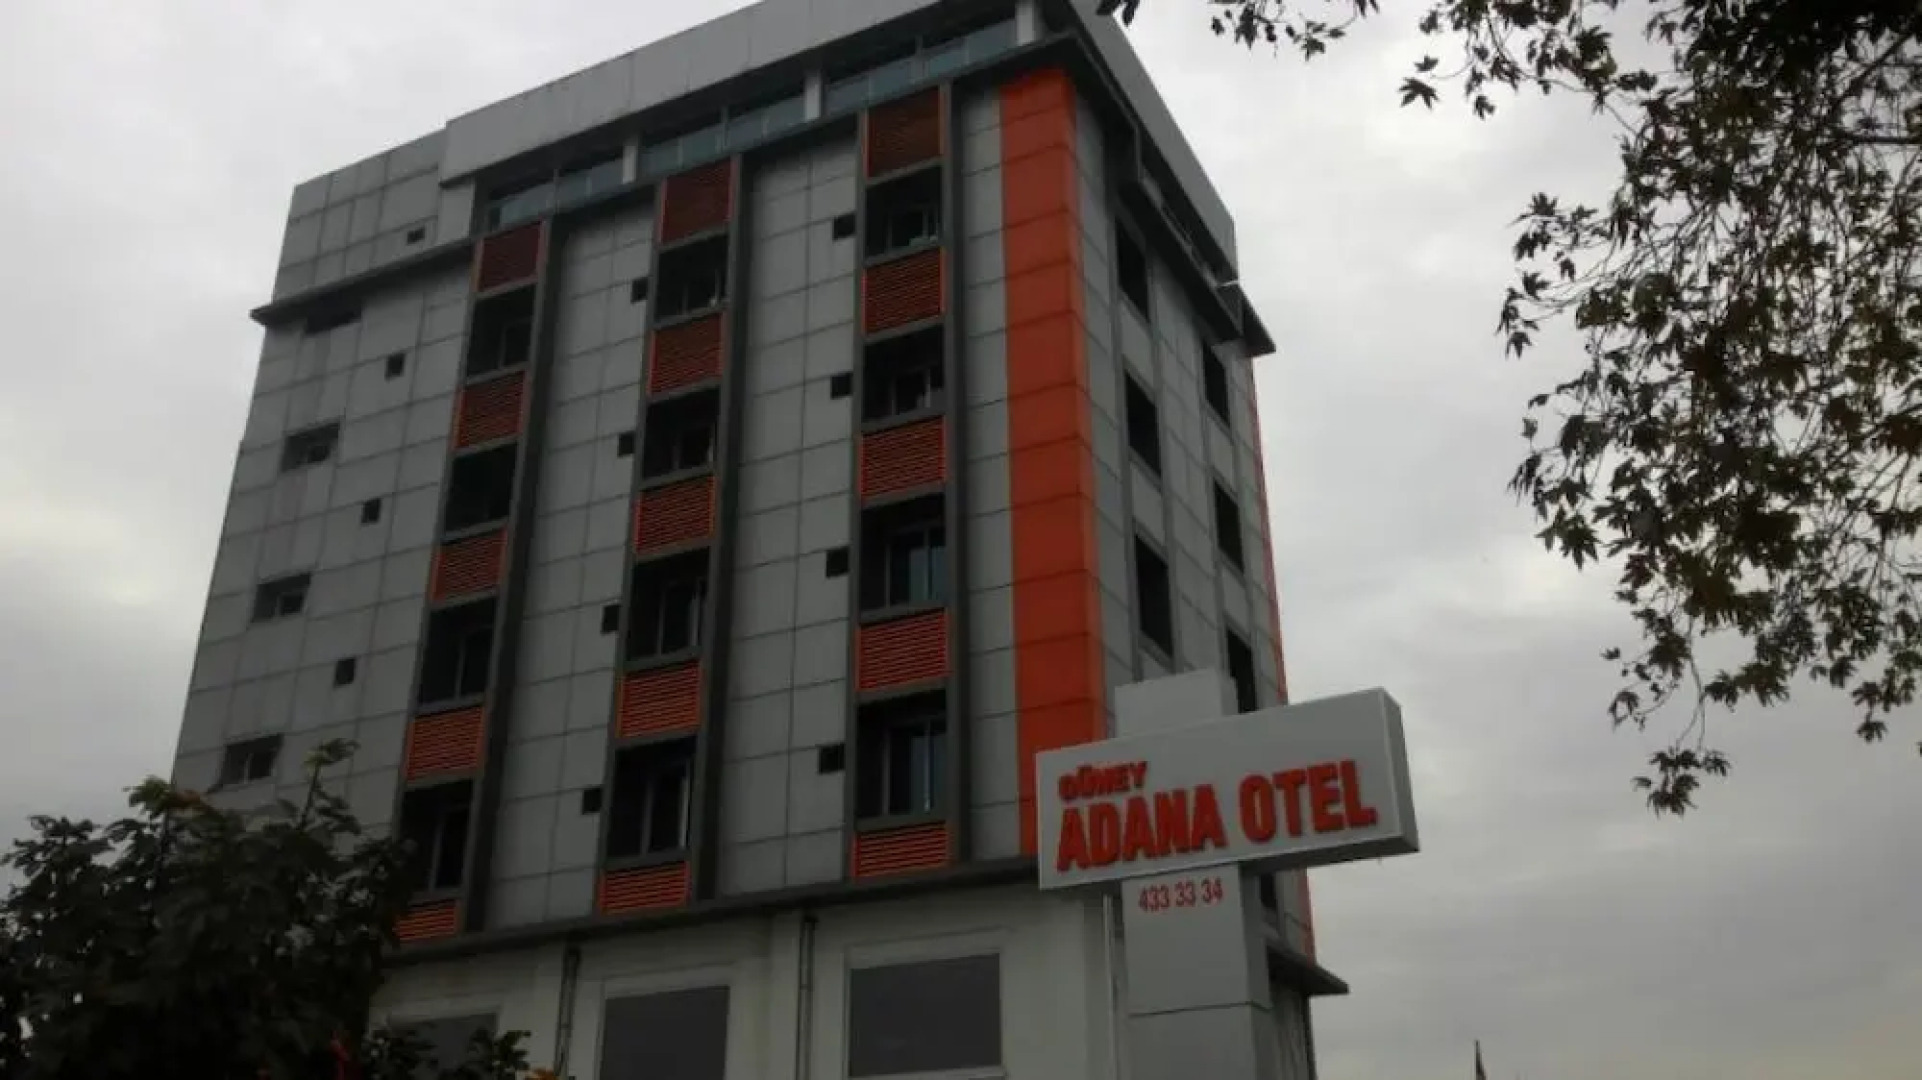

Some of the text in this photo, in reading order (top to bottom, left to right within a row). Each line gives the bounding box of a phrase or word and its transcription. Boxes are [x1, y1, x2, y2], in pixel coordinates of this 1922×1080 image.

[1056, 760, 1377, 872] ADANA OTEL
[1139, 876, 1223, 912] 433 33 34
